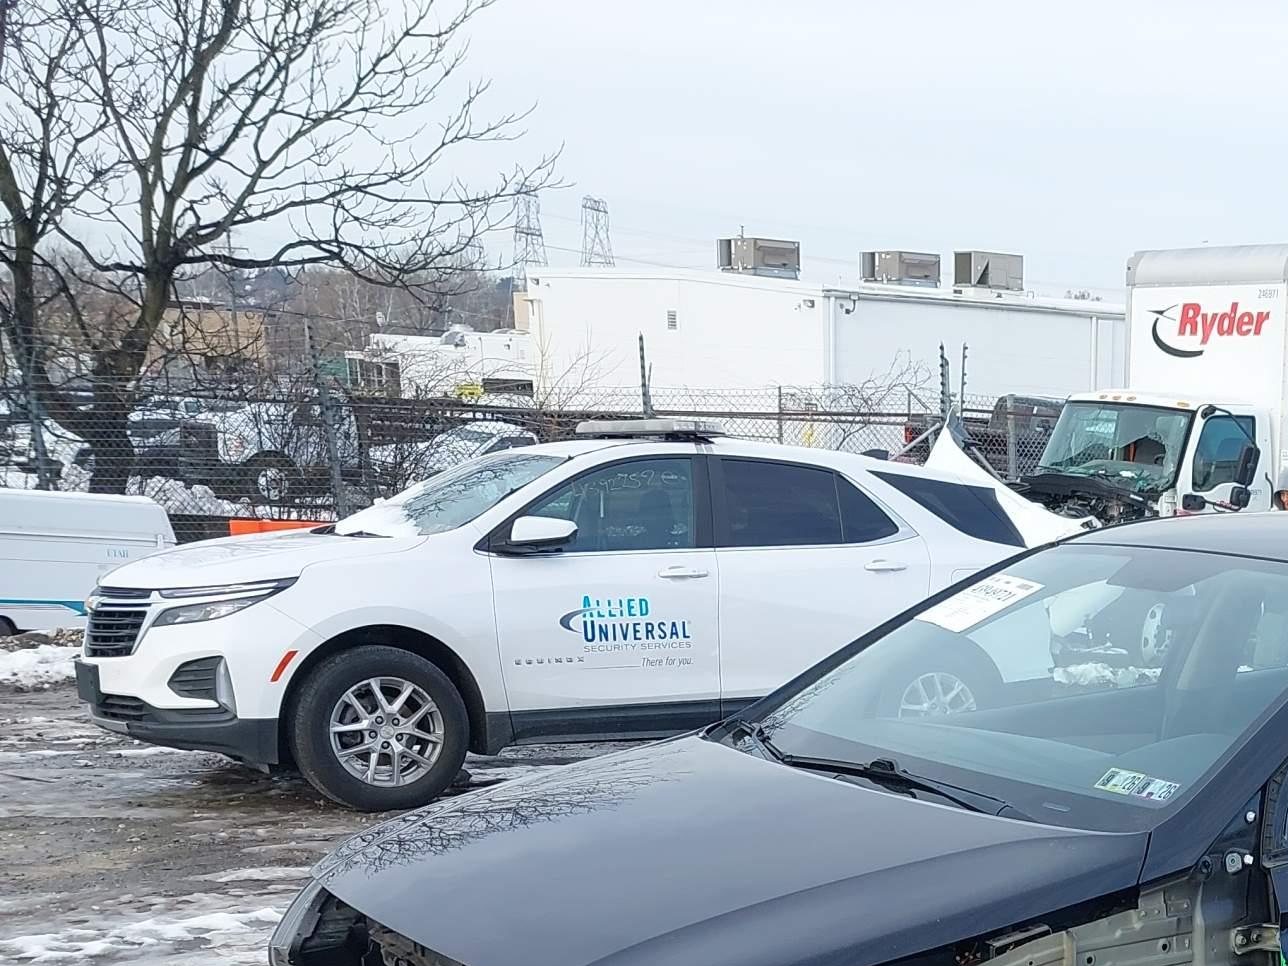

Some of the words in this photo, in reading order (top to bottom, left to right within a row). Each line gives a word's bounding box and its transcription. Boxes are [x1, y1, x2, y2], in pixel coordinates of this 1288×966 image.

[1177, 302, 1270, 345] Ryder
[582, 595, 649, 618] ALLIED
[583, 620, 691, 643] UNIVERSAL
[583, 643, 637, 653] SECURITY
[640, 641, 692, 651] SERVICES
[642, 657, 663, 667] There
[665, 656, 676, 667] for
[677, 657, 694, 668] you.
